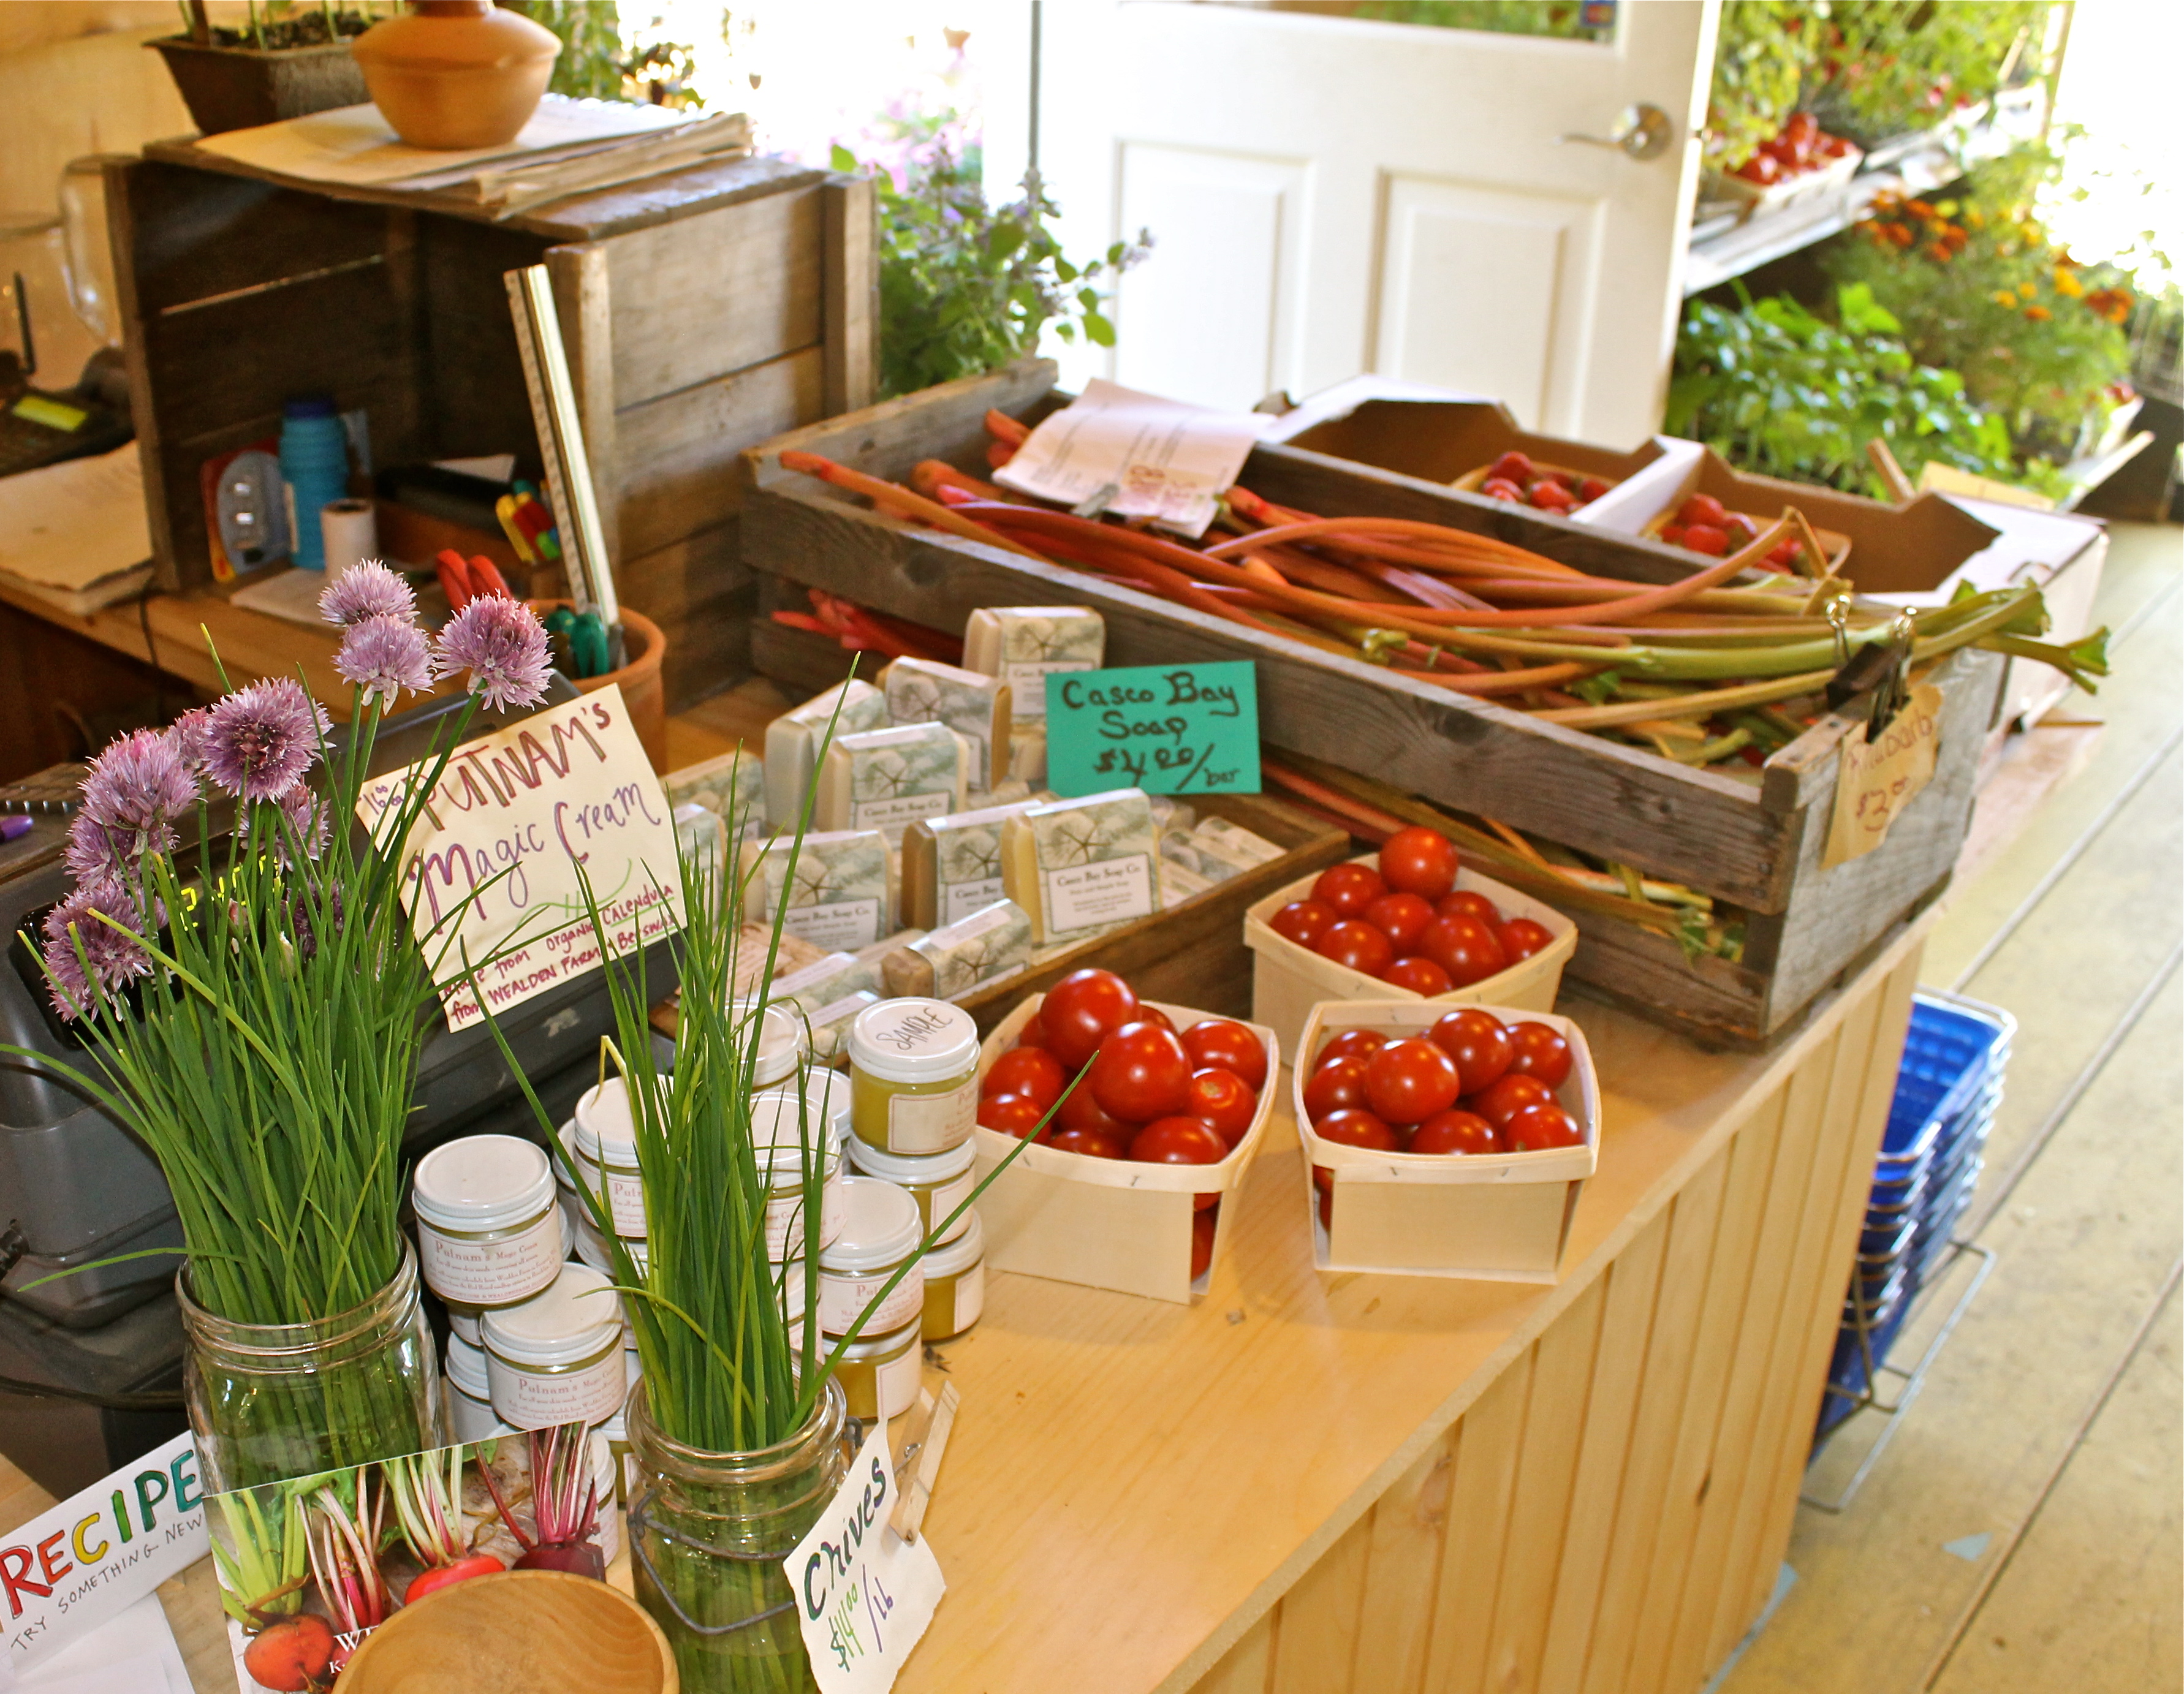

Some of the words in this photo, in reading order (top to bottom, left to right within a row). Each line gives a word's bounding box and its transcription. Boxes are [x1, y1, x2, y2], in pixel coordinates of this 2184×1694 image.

[1062, 679, 1155, 710] Casco
[1162, 671, 1240, 717] Bay
[1099, 710, 1188, 746] Soap
[408, 824, 544, 934] Magic
[554, 782, 661, 863] Cream
[488, 965, 557, 1005] WEALDEN
[561, 947, 601, 975] FARM
[494, 951, 531, 979] from
[876, 1007, 953, 1051] SAMPLE
[436, 1239, 490, 1261] Putnam's
[519, 1378, 578, 1394] Putnam's
[0, 1450, 203, 1619] RECIPE
[804, 1456, 887, 1621] Chives
[10, 1616, 47, 1650] TRY
[58, 1543, 159, 1614] SOMETHING
[165, 1514, 203, 1545] NEW
